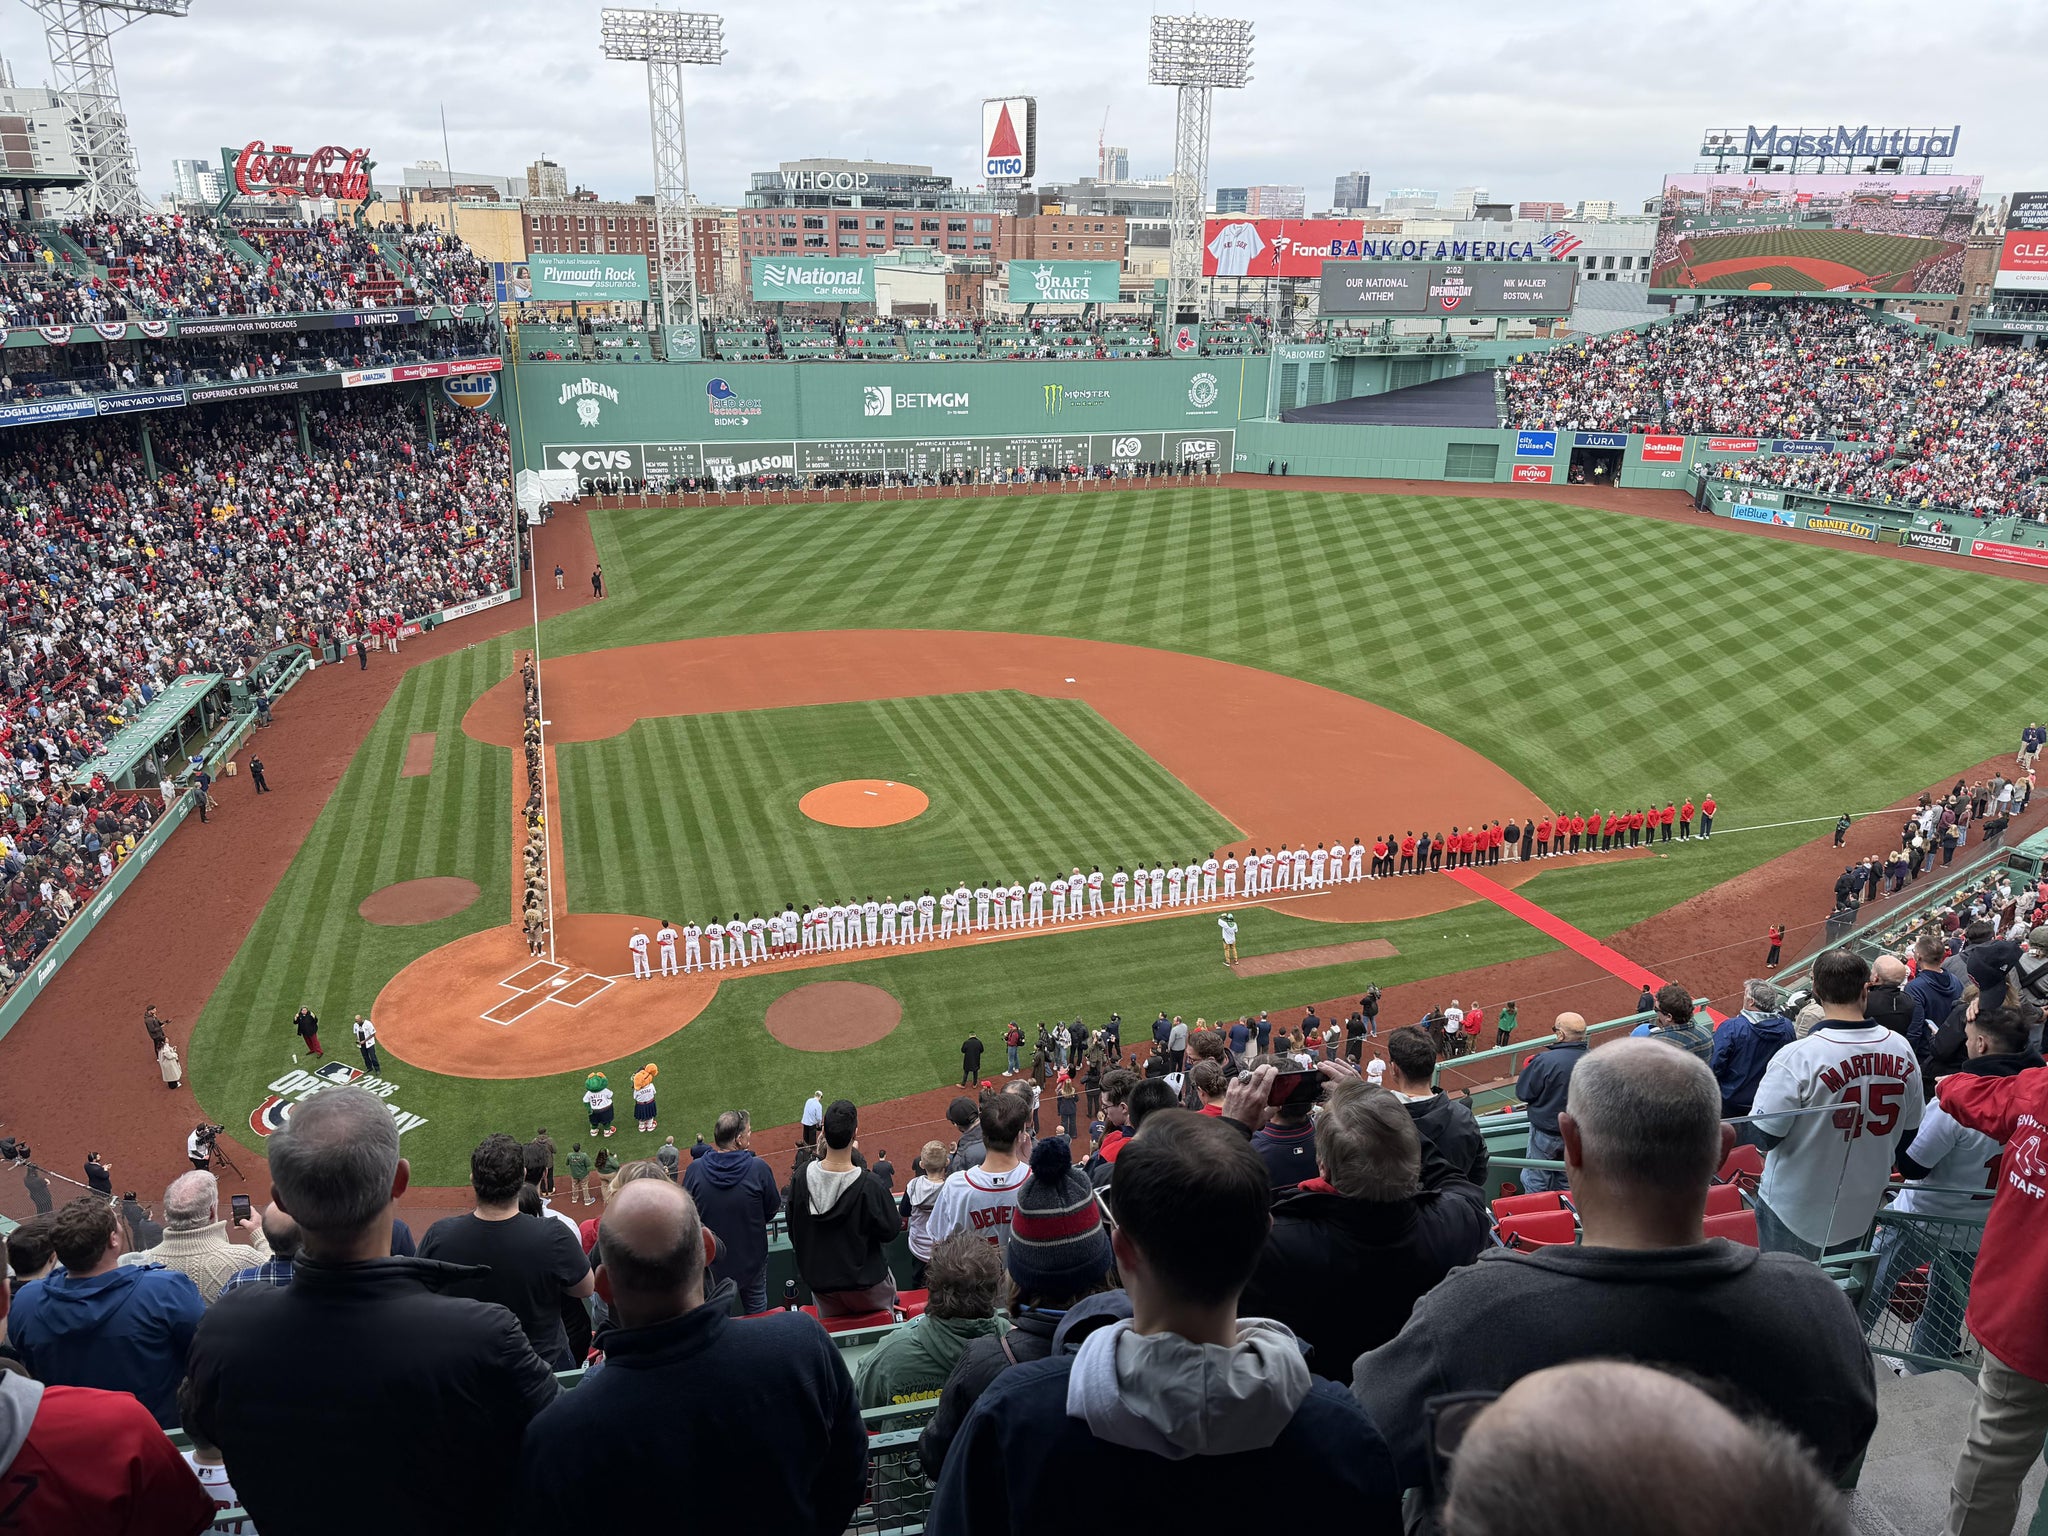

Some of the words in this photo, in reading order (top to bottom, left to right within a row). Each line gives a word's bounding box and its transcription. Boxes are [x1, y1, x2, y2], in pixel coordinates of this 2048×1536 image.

[1745, 125, 1961, 157] MassMutual
[235, 140, 371, 200] Coca-Cola
[987, 158, 1022, 175] CITGO
[781, 171, 869, 191] WHOOP
[1330, 239, 1392, 257] BANK
[1402, 239, 1428, 257] OF
[1435, 240, 1534, 258] AMERICA
[538, 257, 551, 265] More
[551, 257, 564, 265] Than
[543, 267, 601, 283] Plymouth
[604, 267, 635, 281] Rock
[1446, 266, 1462, 274] 2:02
[1035, 275, 1092, 291] DRAFT
[1346, 278, 1363, 288] OUR
[1365, 278, 1408, 288] NATIONAL
[1503, 279, 1516, 288] NIK
[1517, 279, 1546, 288] WALKER
[813, 286, 829, 295] Car
[832, 286, 860, 295] Rental
[1042, 288, 1090, 300] KINGS
[1359, 292, 1394, 301] ANTHEM
[1430, 286, 1454, 297] OPENING
[1454, 286, 1473, 297] DAY
[1503, 292, 1531, 301] BOSTON,
[1532, 292, 1544, 300] MA
[364, 313, 398, 324] UNITED
[181, 322, 236, 335] PERFORMERWITH
[237, 322, 253, 331] OVER
[254, 322, 269, 330] TWO
[271, 320, 297, 329] DECADES
[2003, 322, 2033, 331] WELCOME
[1285, 350, 1325, 359] ABIOMED
[451, 364, 476, 372] Safelite
[192, 388, 238, 400] OFEXPERIENCE
[251, 385, 266, 394] BOTH
[268, 384, 280, 392] THE
[281, 382, 298, 391] STAGE
[444, 377, 492, 393] Gulf
[559, 381, 582, 405] JIM
[582, 377, 618, 405] BEAM
[108, 397, 154, 408] VINEYARD
[156, 393, 183, 404] VINES
[895, 393, 969, 408] BETMGM
[1064, 390, 1110, 399] MONSTER
[40, 400, 94, 413] COMPANIES
[714, 399, 736, 407] RED
[739, 399, 761, 407] SOX
[1112, 437, 1142, 458] 160
[1185, 440, 1216, 455] ACE
[1644, 443, 1682, 451] Safelite
[1728, 441, 1758, 450] TICKET
[582, 450, 632, 470] CVS
[720, 456, 733, 464] BUT
[1235, 453, 1248, 461] 379
[738, 455, 794, 476] MASON
[576, 471, 634, 490] ealth
[1518, 470, 1546, 478] IRVING
[1661, 470, 1675, 478] 420
[1735, 506, 1768, 520] jetBlue
[1808, 518, 1849, 531] GRANITE
[1850, 523, 1872, 537] CITY
[1911, 533, 1953, 547] wasabi
[464, 603, 477, 611] TRULY
[1820, 1053, 1916, 1094] MARTINEZ
[356, 1074, 400, 1098] 2026
[591, 1098, 603, 1106] 97
[1832, 1083, 1905, 1143] 45
[2009, 1170, 2046, 1199] STAFF
[969, 1206, 1016, 1230] DEVE
